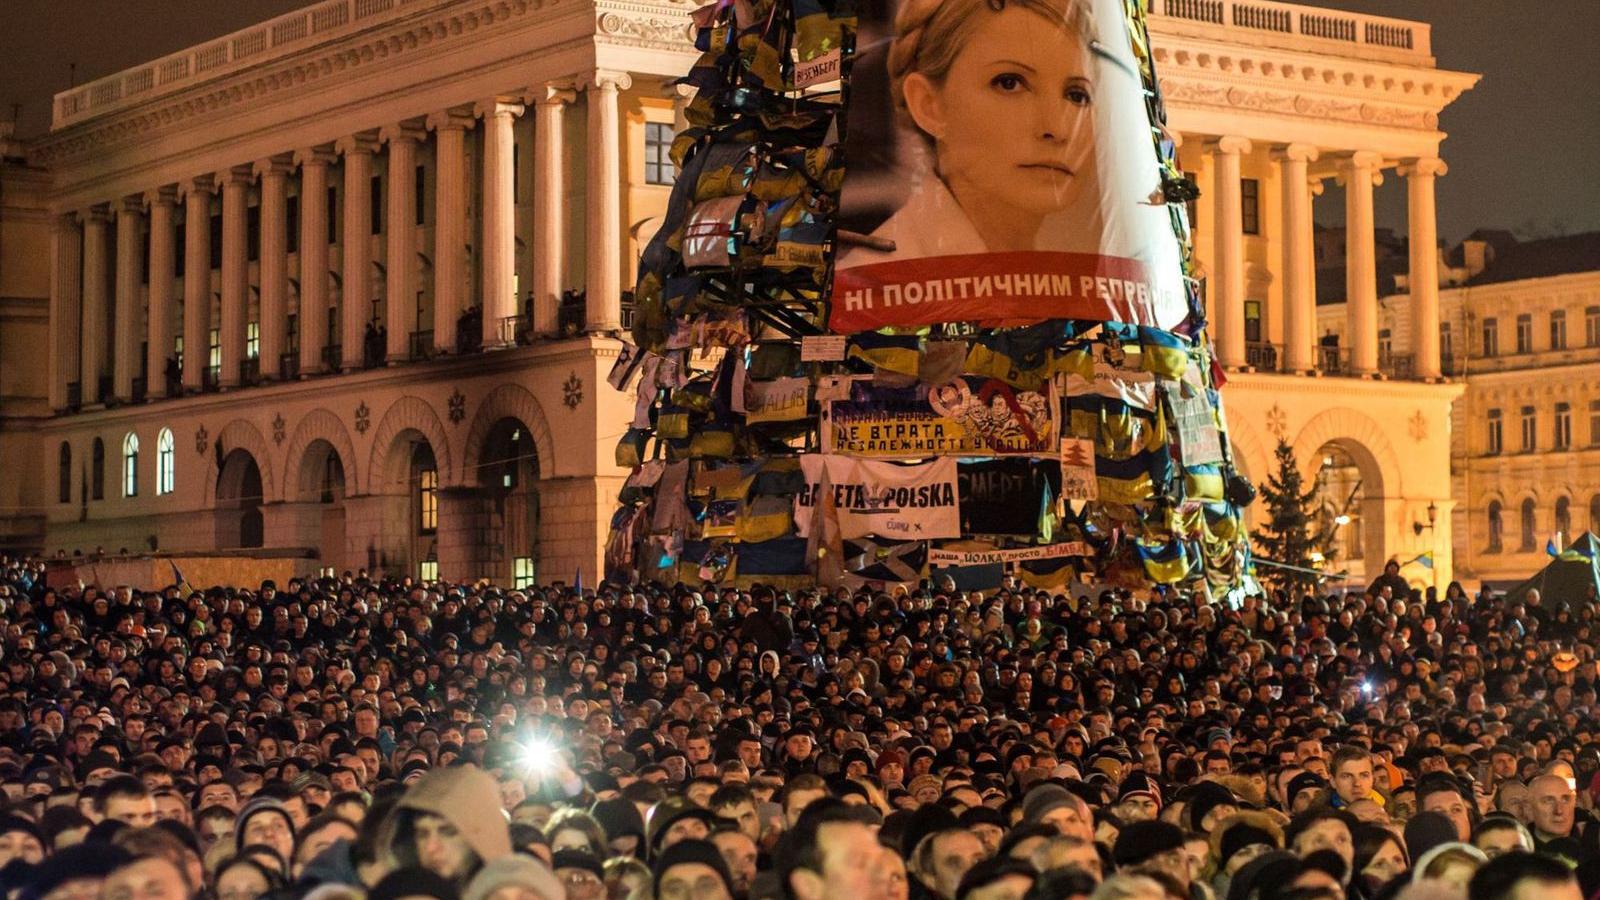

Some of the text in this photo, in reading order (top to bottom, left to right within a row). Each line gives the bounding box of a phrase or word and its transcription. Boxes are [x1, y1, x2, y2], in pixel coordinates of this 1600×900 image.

[844, 288, 873, 312] НІ
[883, 273, 1072, 307] ПОЛІТИЧНИМ
[837, 424, 944, 442] ЦЕ ВТРАТА
[836, 438, 964, 451] НЕЗАЛЕЖНОСТІ
[799, 482, 954, 508] GAETA POLSKA
